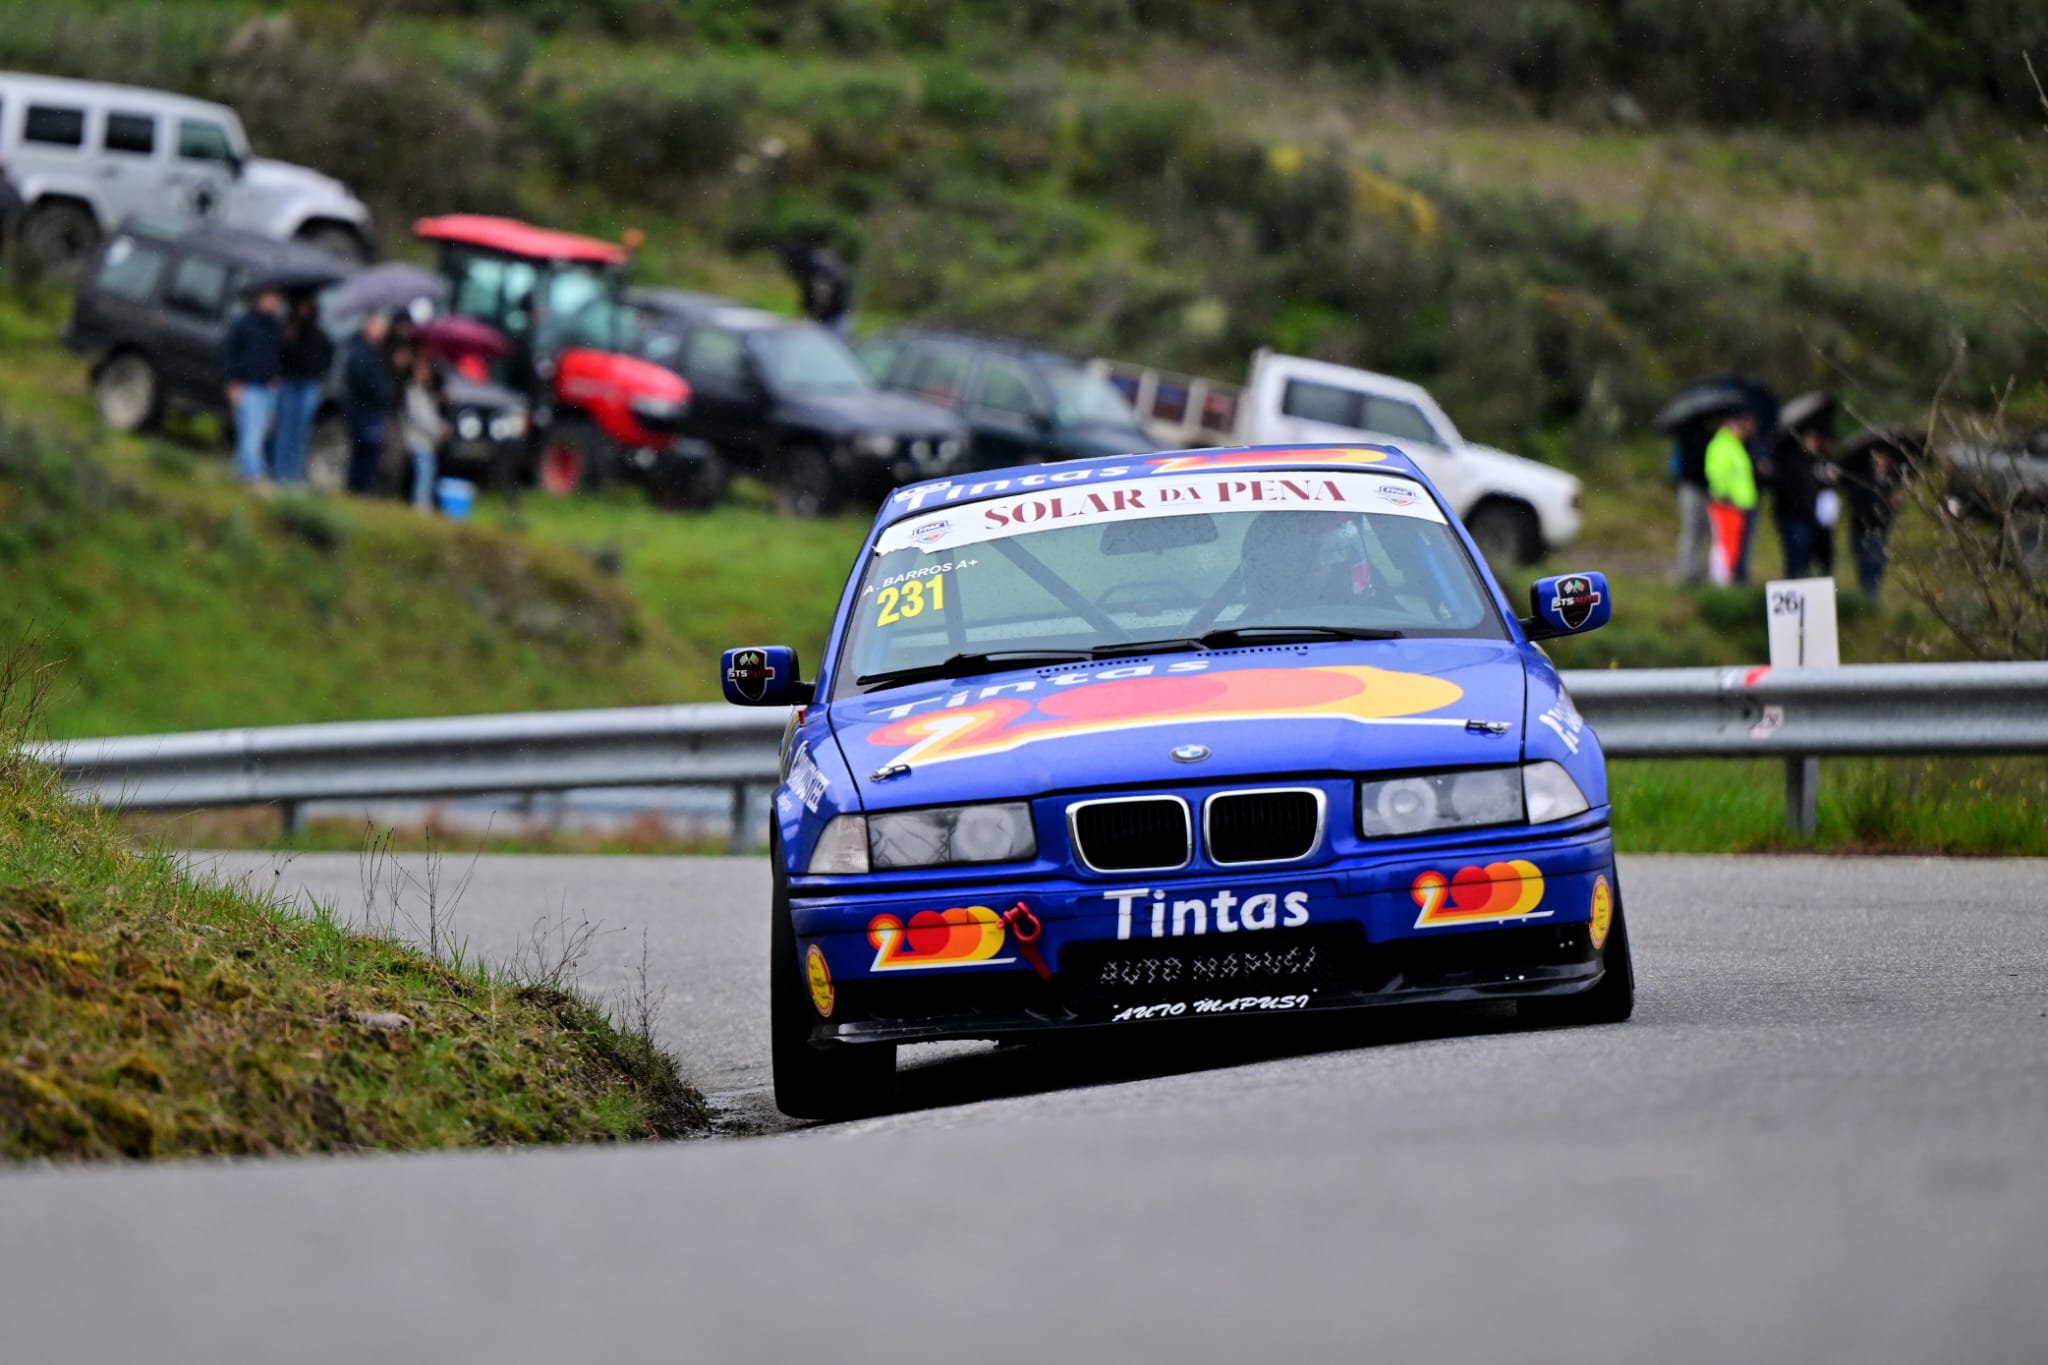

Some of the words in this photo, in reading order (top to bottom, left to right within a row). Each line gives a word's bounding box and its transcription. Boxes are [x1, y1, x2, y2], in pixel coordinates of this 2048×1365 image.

[894, 465, 1131, 511] Tintas
[984, 489, 1146, 530] SOLAR
[1160, 486, 1201, 502] DA
[1217, 479, 1347, 502] PENA
[883, 562, 952, 588] BARROS
[956, 560, 978, 570] A+
[877, 574, 944, 627] 231
[1773, 590, 1798, 614] 26
[869, 661, 1209, 720] Tintas
[1104, 888, 1310, 940] Tintas
[1112, 1002, 1187, 1022] AUTO
[1193, 995, 1310, 1014] MAPUSI
